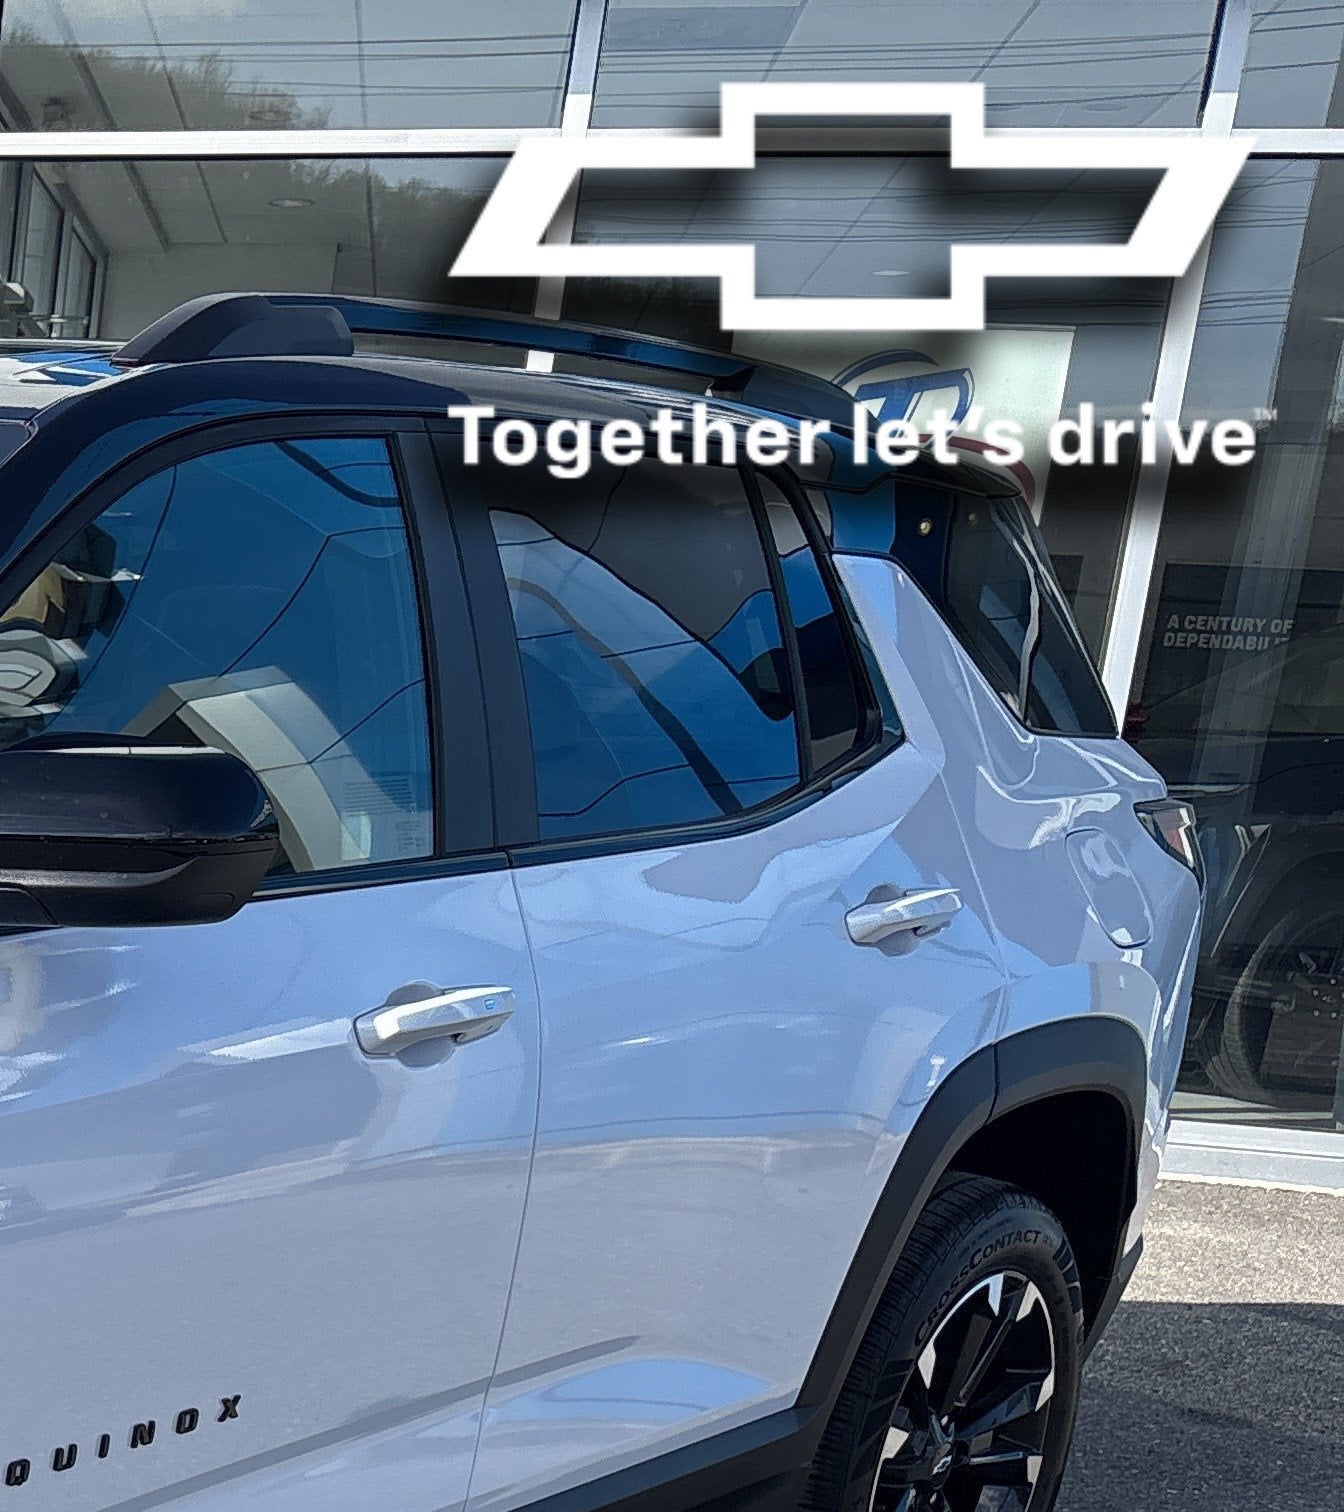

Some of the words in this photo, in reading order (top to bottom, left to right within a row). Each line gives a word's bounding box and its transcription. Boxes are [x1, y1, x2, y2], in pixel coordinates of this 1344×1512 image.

[1167, 614, 1180, 630] A
[1184, 615, 1269, 633] CENTURY
[1270, 618, 1296, 634] OF
